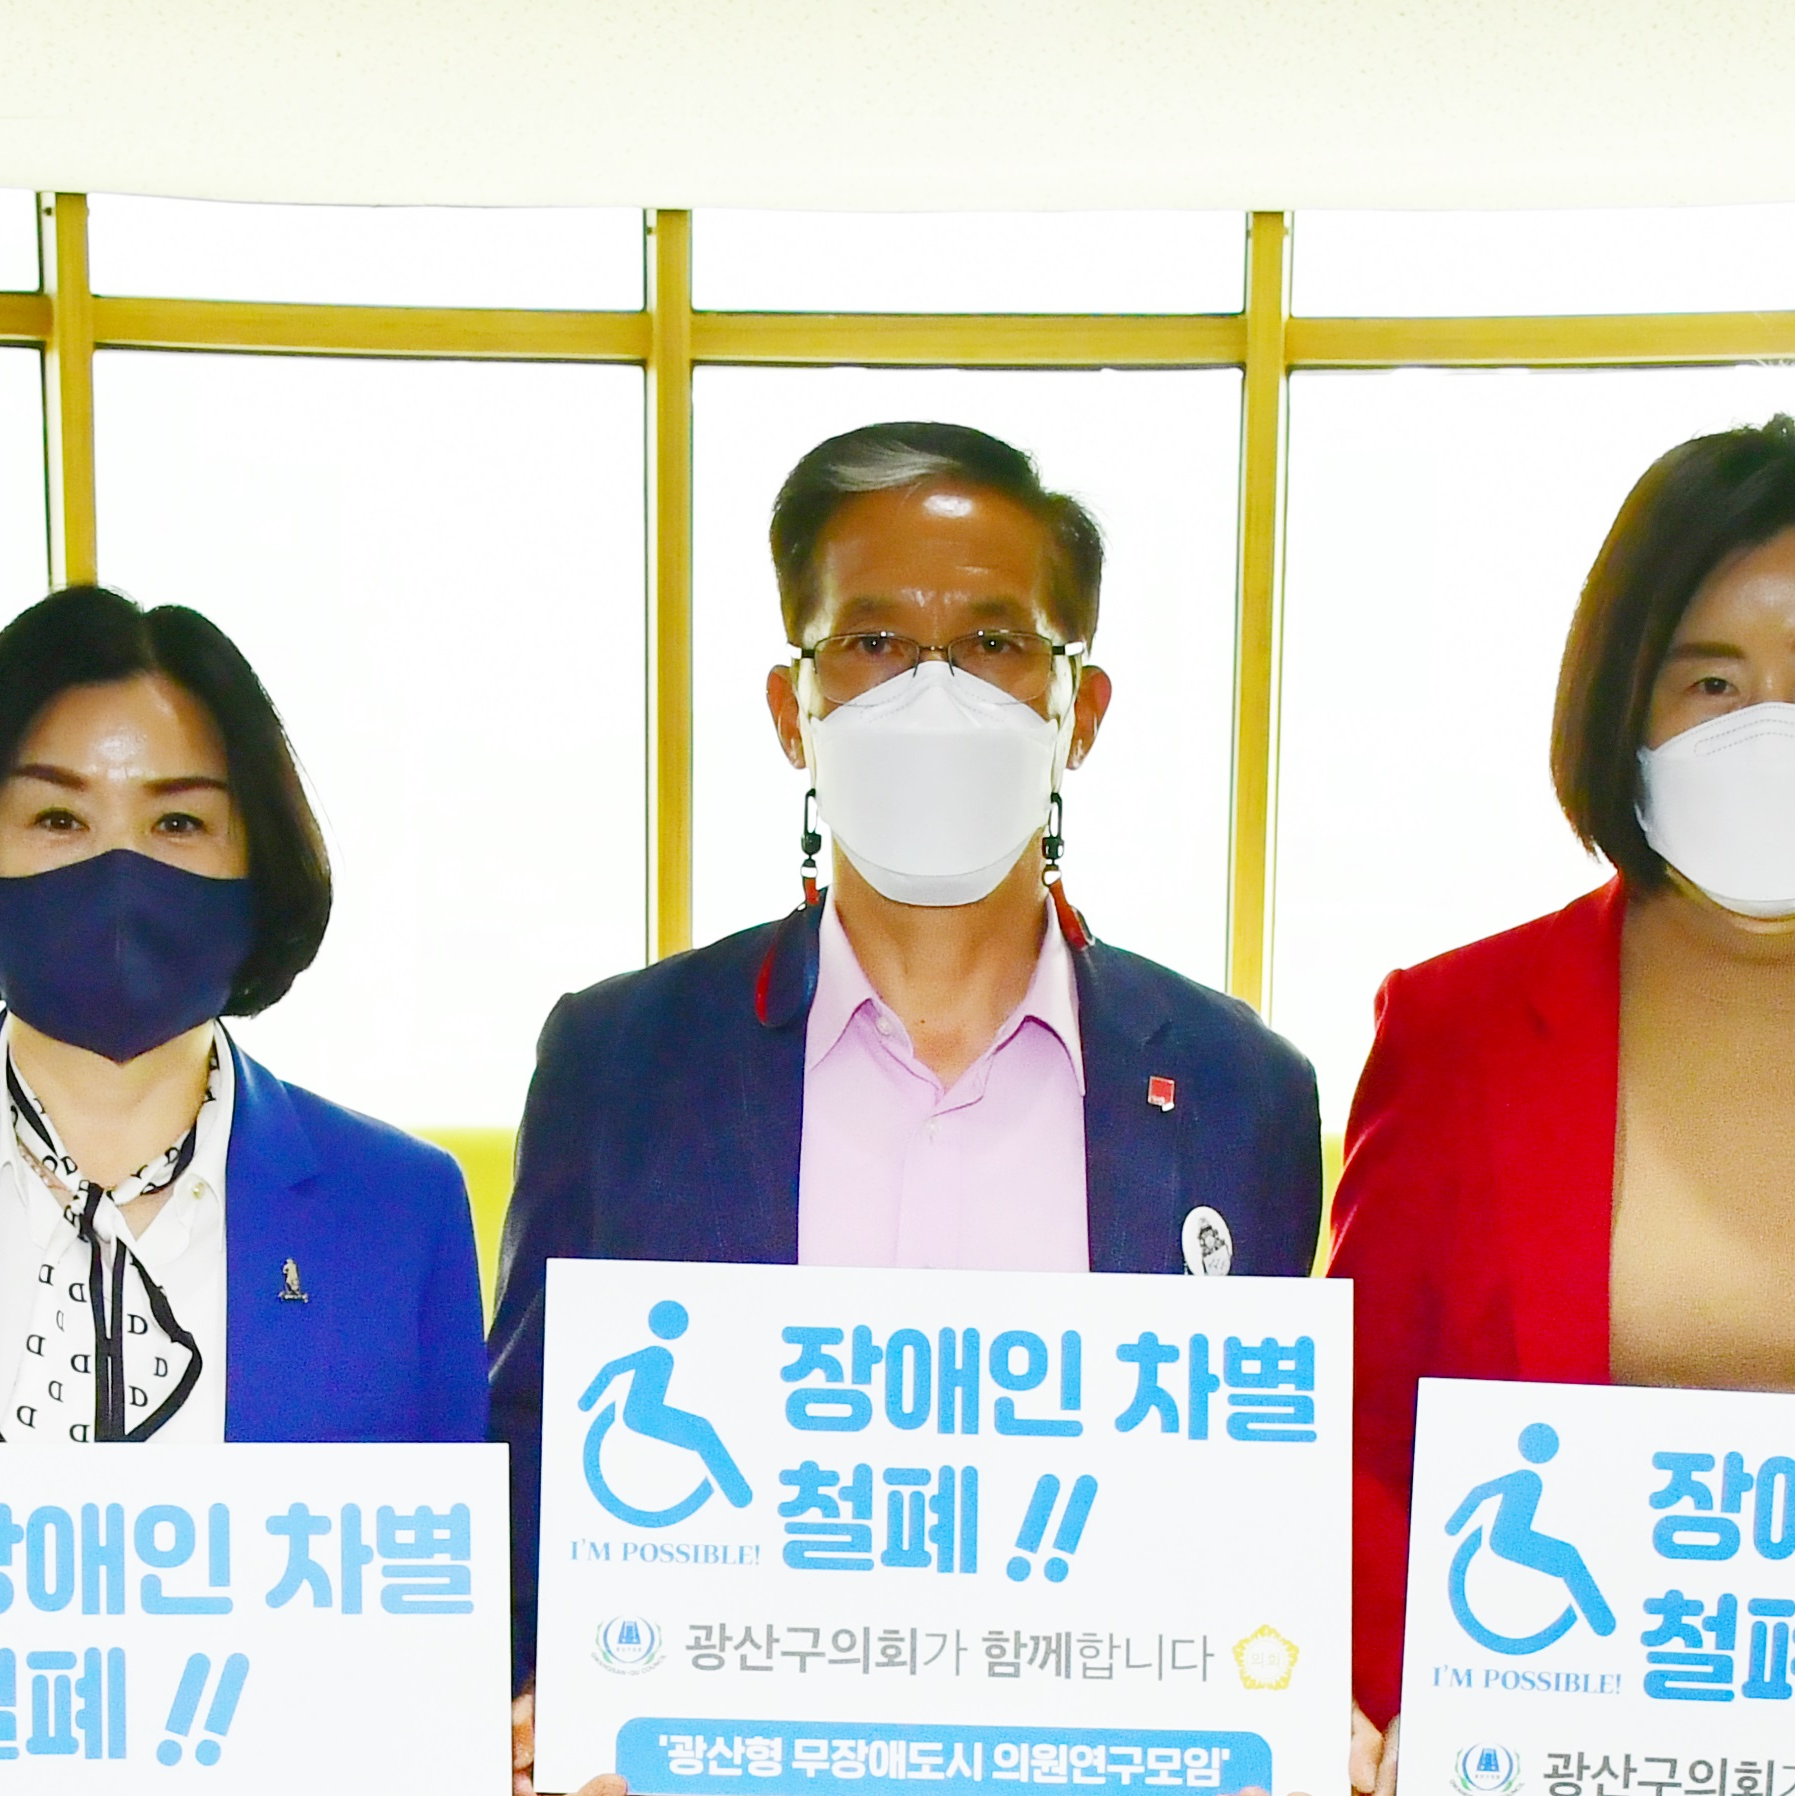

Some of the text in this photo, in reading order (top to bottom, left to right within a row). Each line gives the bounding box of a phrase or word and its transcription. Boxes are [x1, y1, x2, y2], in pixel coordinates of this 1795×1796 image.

[127, 1313, 149, 1335] D
[129, 1385, 149, 1407] D
[780, 1324, 1318, 1443] 장애인 차별
[777, 1460, 1099, 1583] 철폐 !!
[265, 1501, 474, 1615] 차별
[570, 1540, 761, 1566] I'M POSSIBLE!
[685, 1622, 1215, 1683] 광산구의회가 함께합니다
[1433, 1666, 1622, 1695] I'M POSSIBLE!
[156, 1652, 250, 1767] !!
[658, 1734, 1231, 1788] '광산형 무장애도시 의원연구모임'
